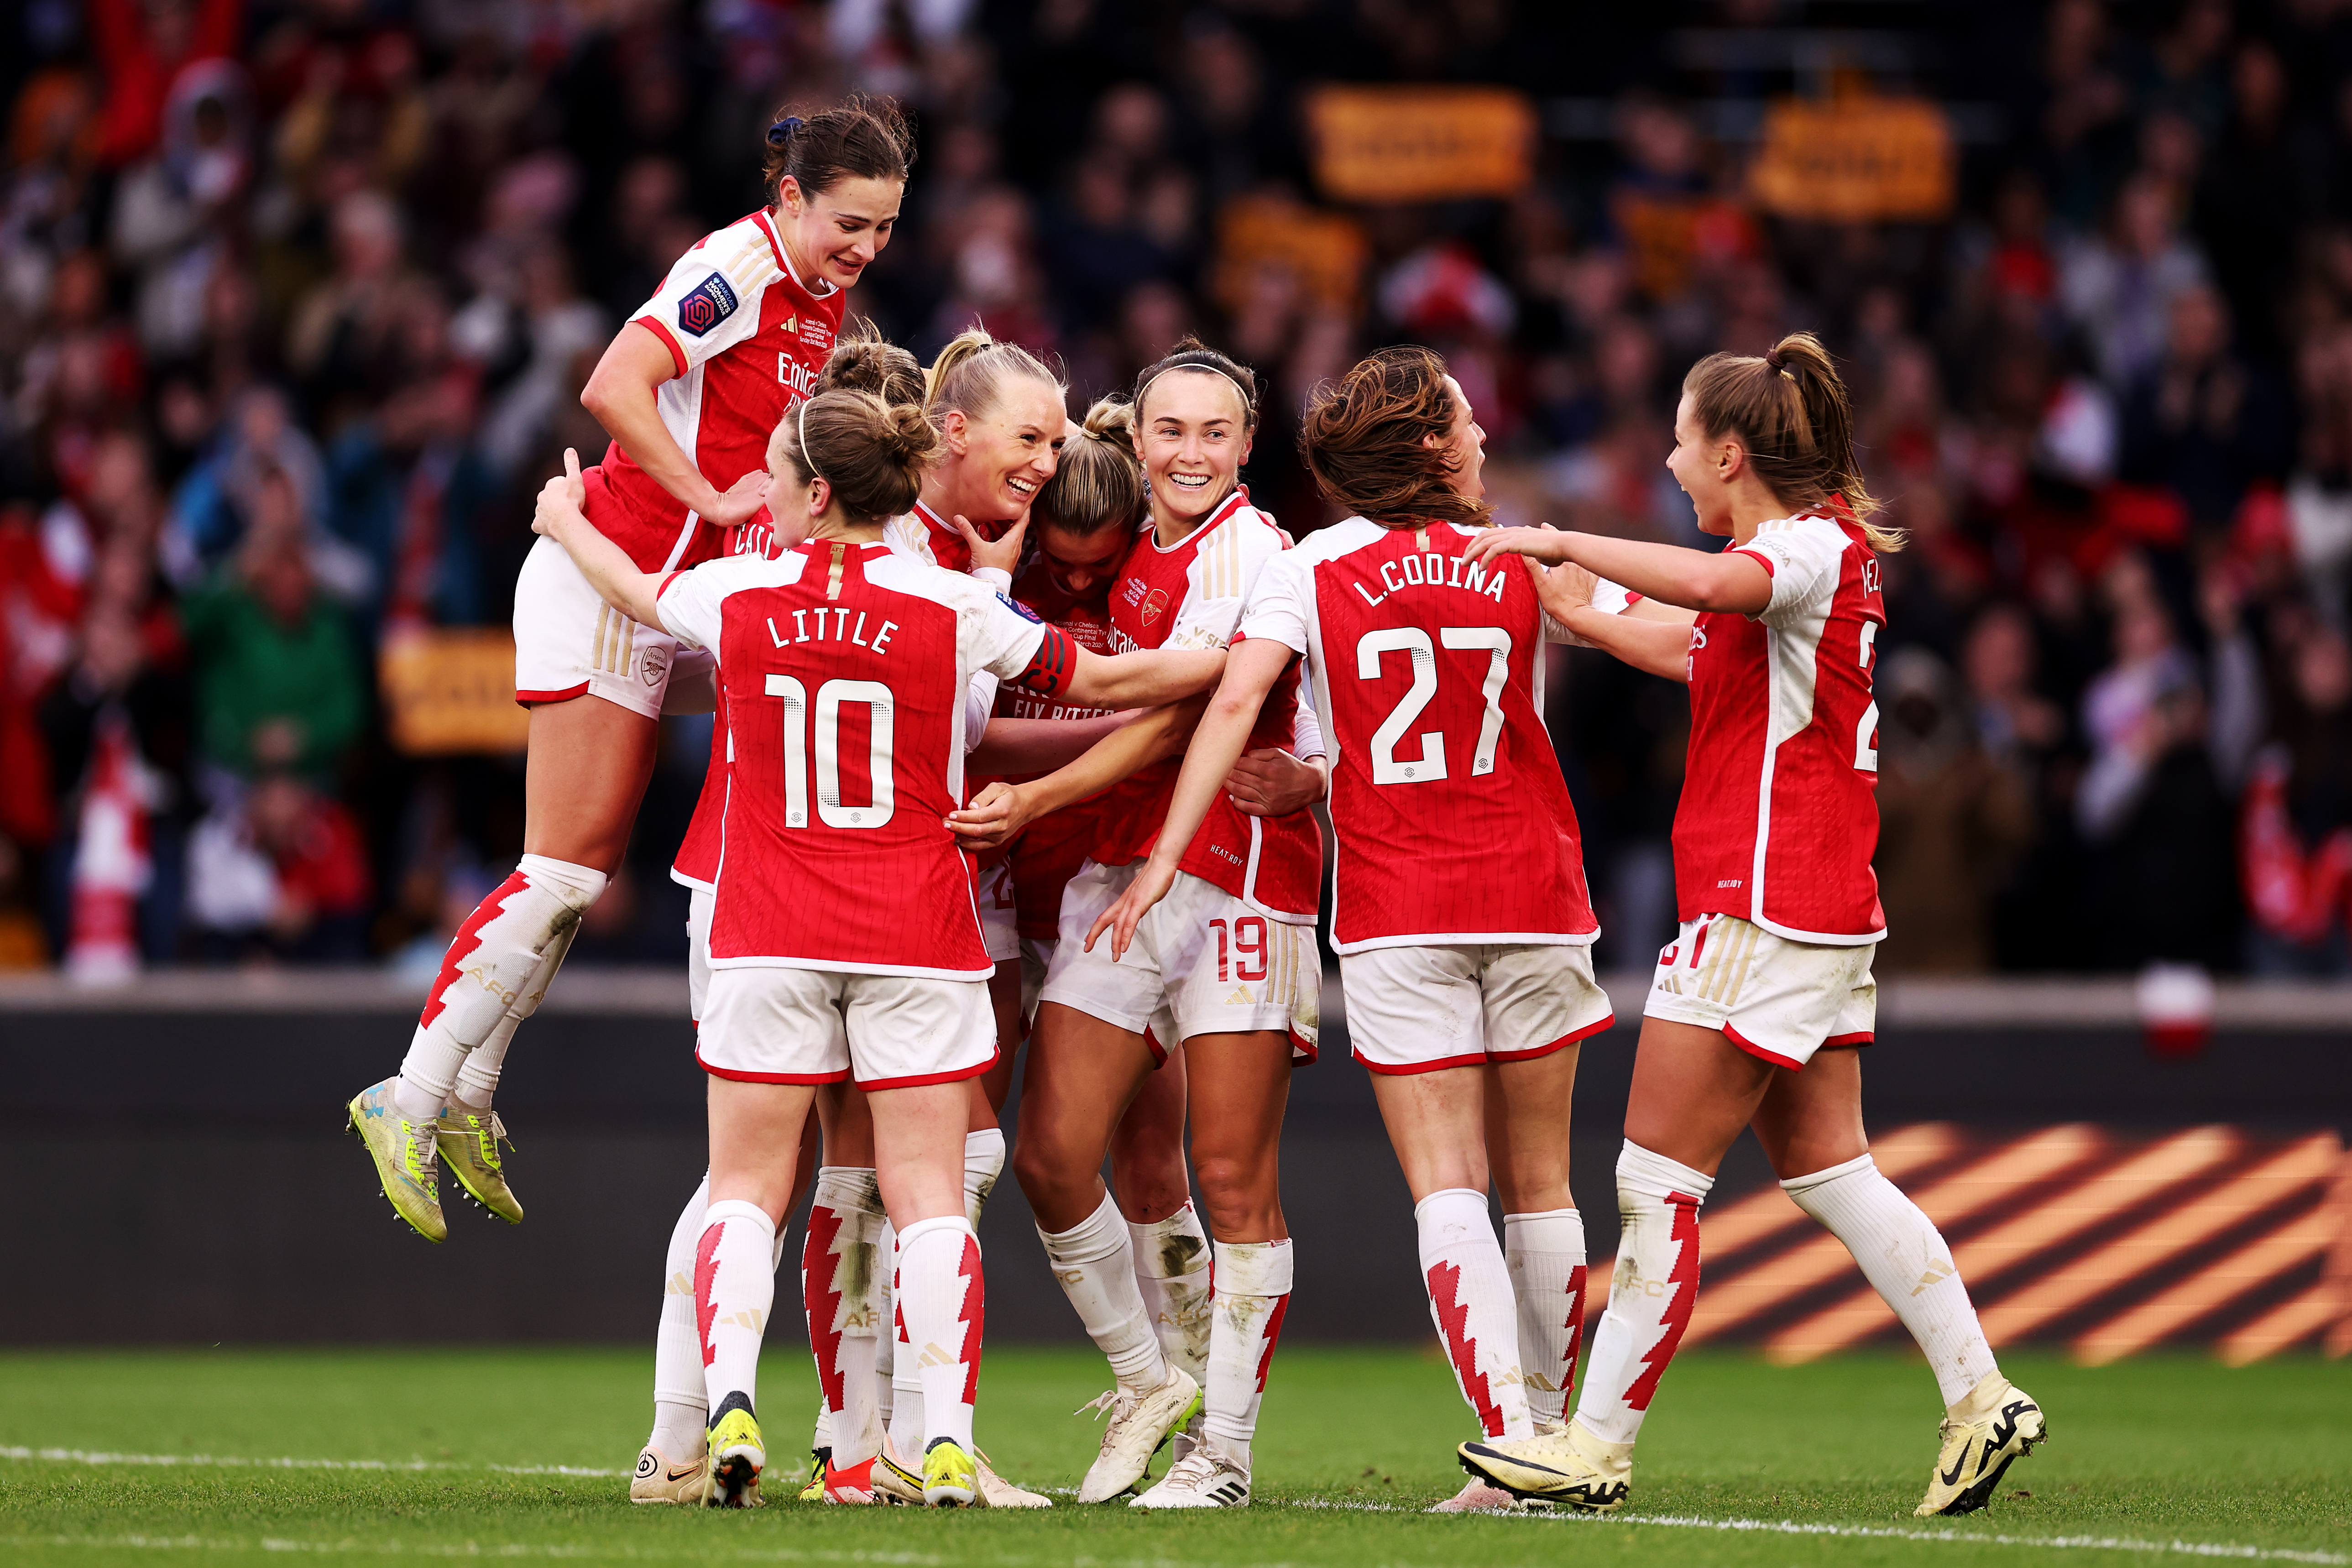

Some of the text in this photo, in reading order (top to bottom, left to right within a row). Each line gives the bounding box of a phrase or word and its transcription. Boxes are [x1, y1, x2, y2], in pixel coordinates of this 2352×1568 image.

[705, 284, 726, 316] SUPER LEAGUE
[708, 281, 730, 313] WOMEN'S
[718, 283, 735, 309] BARCLAYS
[778, 352, 819, 397] Emira
[767, 607, 899, 655] LITTLE
[1173, 632, 1209, 650] RWA
[1194, 626, 1226, 648] VISIT
[1356, 627, 1512, 785] 27
[764, 673, 895, 828] 10
[1210, 844, 1243, 866] HEAT.RDY
[1209, 916, 1268, 982] 19
[466, 967, 517, 1007] AFC
[843, 1311, 880, 1328] AF
[1157, 1304, 1209, 1326] AFC
[1214, 1295, 1267, 1313] AFC
